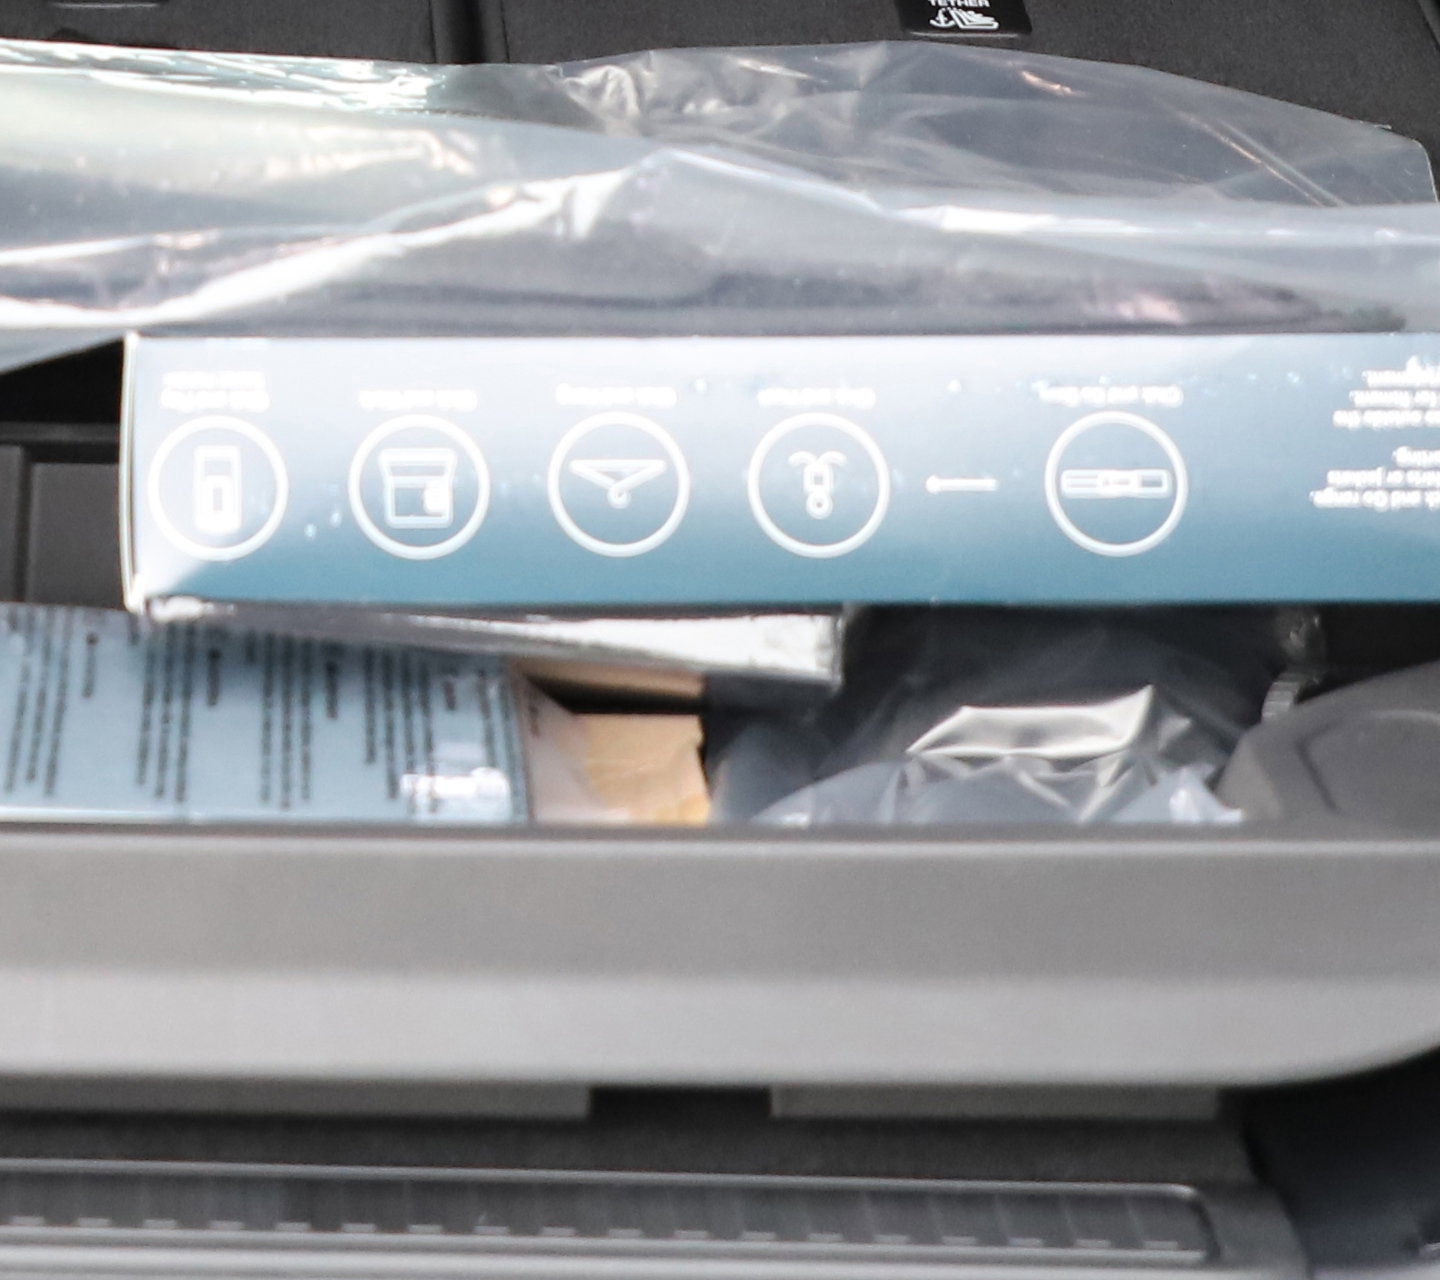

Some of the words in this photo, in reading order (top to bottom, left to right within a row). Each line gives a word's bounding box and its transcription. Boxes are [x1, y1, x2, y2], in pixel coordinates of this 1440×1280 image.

[1326, 465, 1384, 487] jackets
[1385, 470, 1404, 483] or
[1361, 490, 1389, 507] Go
[1388, 490, 1422, 507] and
